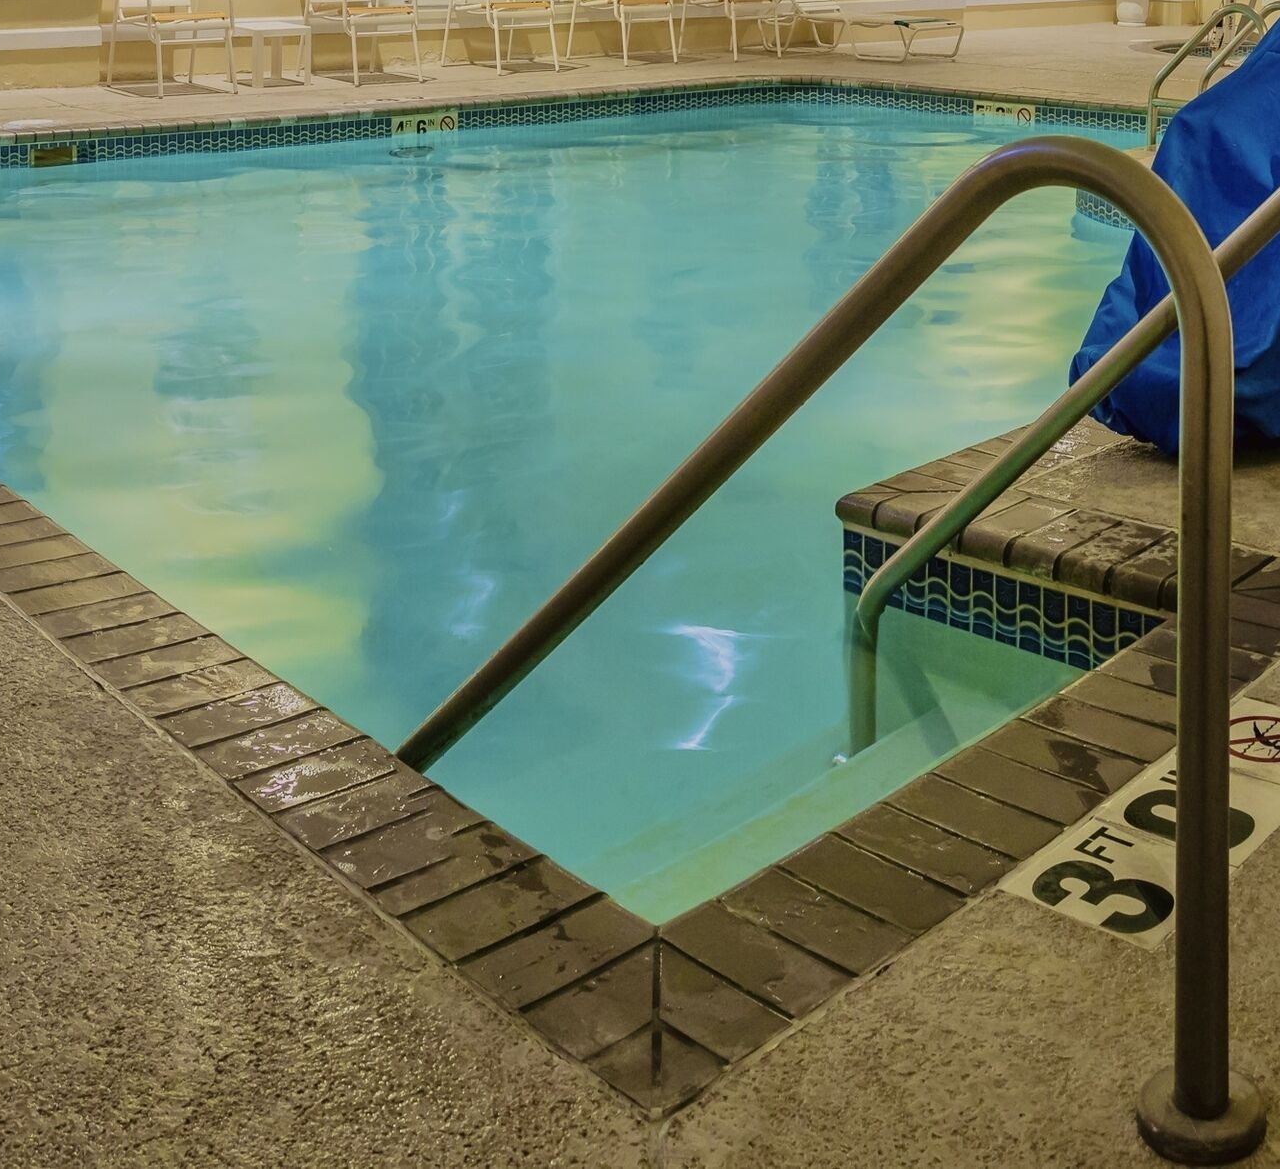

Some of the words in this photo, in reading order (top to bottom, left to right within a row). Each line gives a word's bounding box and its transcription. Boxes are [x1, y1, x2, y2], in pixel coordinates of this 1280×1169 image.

[405, 120, 412, 128] FT
[417, 119, 427, 134] 6
[428, 118, 435, 127] IN
[1073, 826, 1135, 864] FT
[1032, 860, 1175, 934] 3
